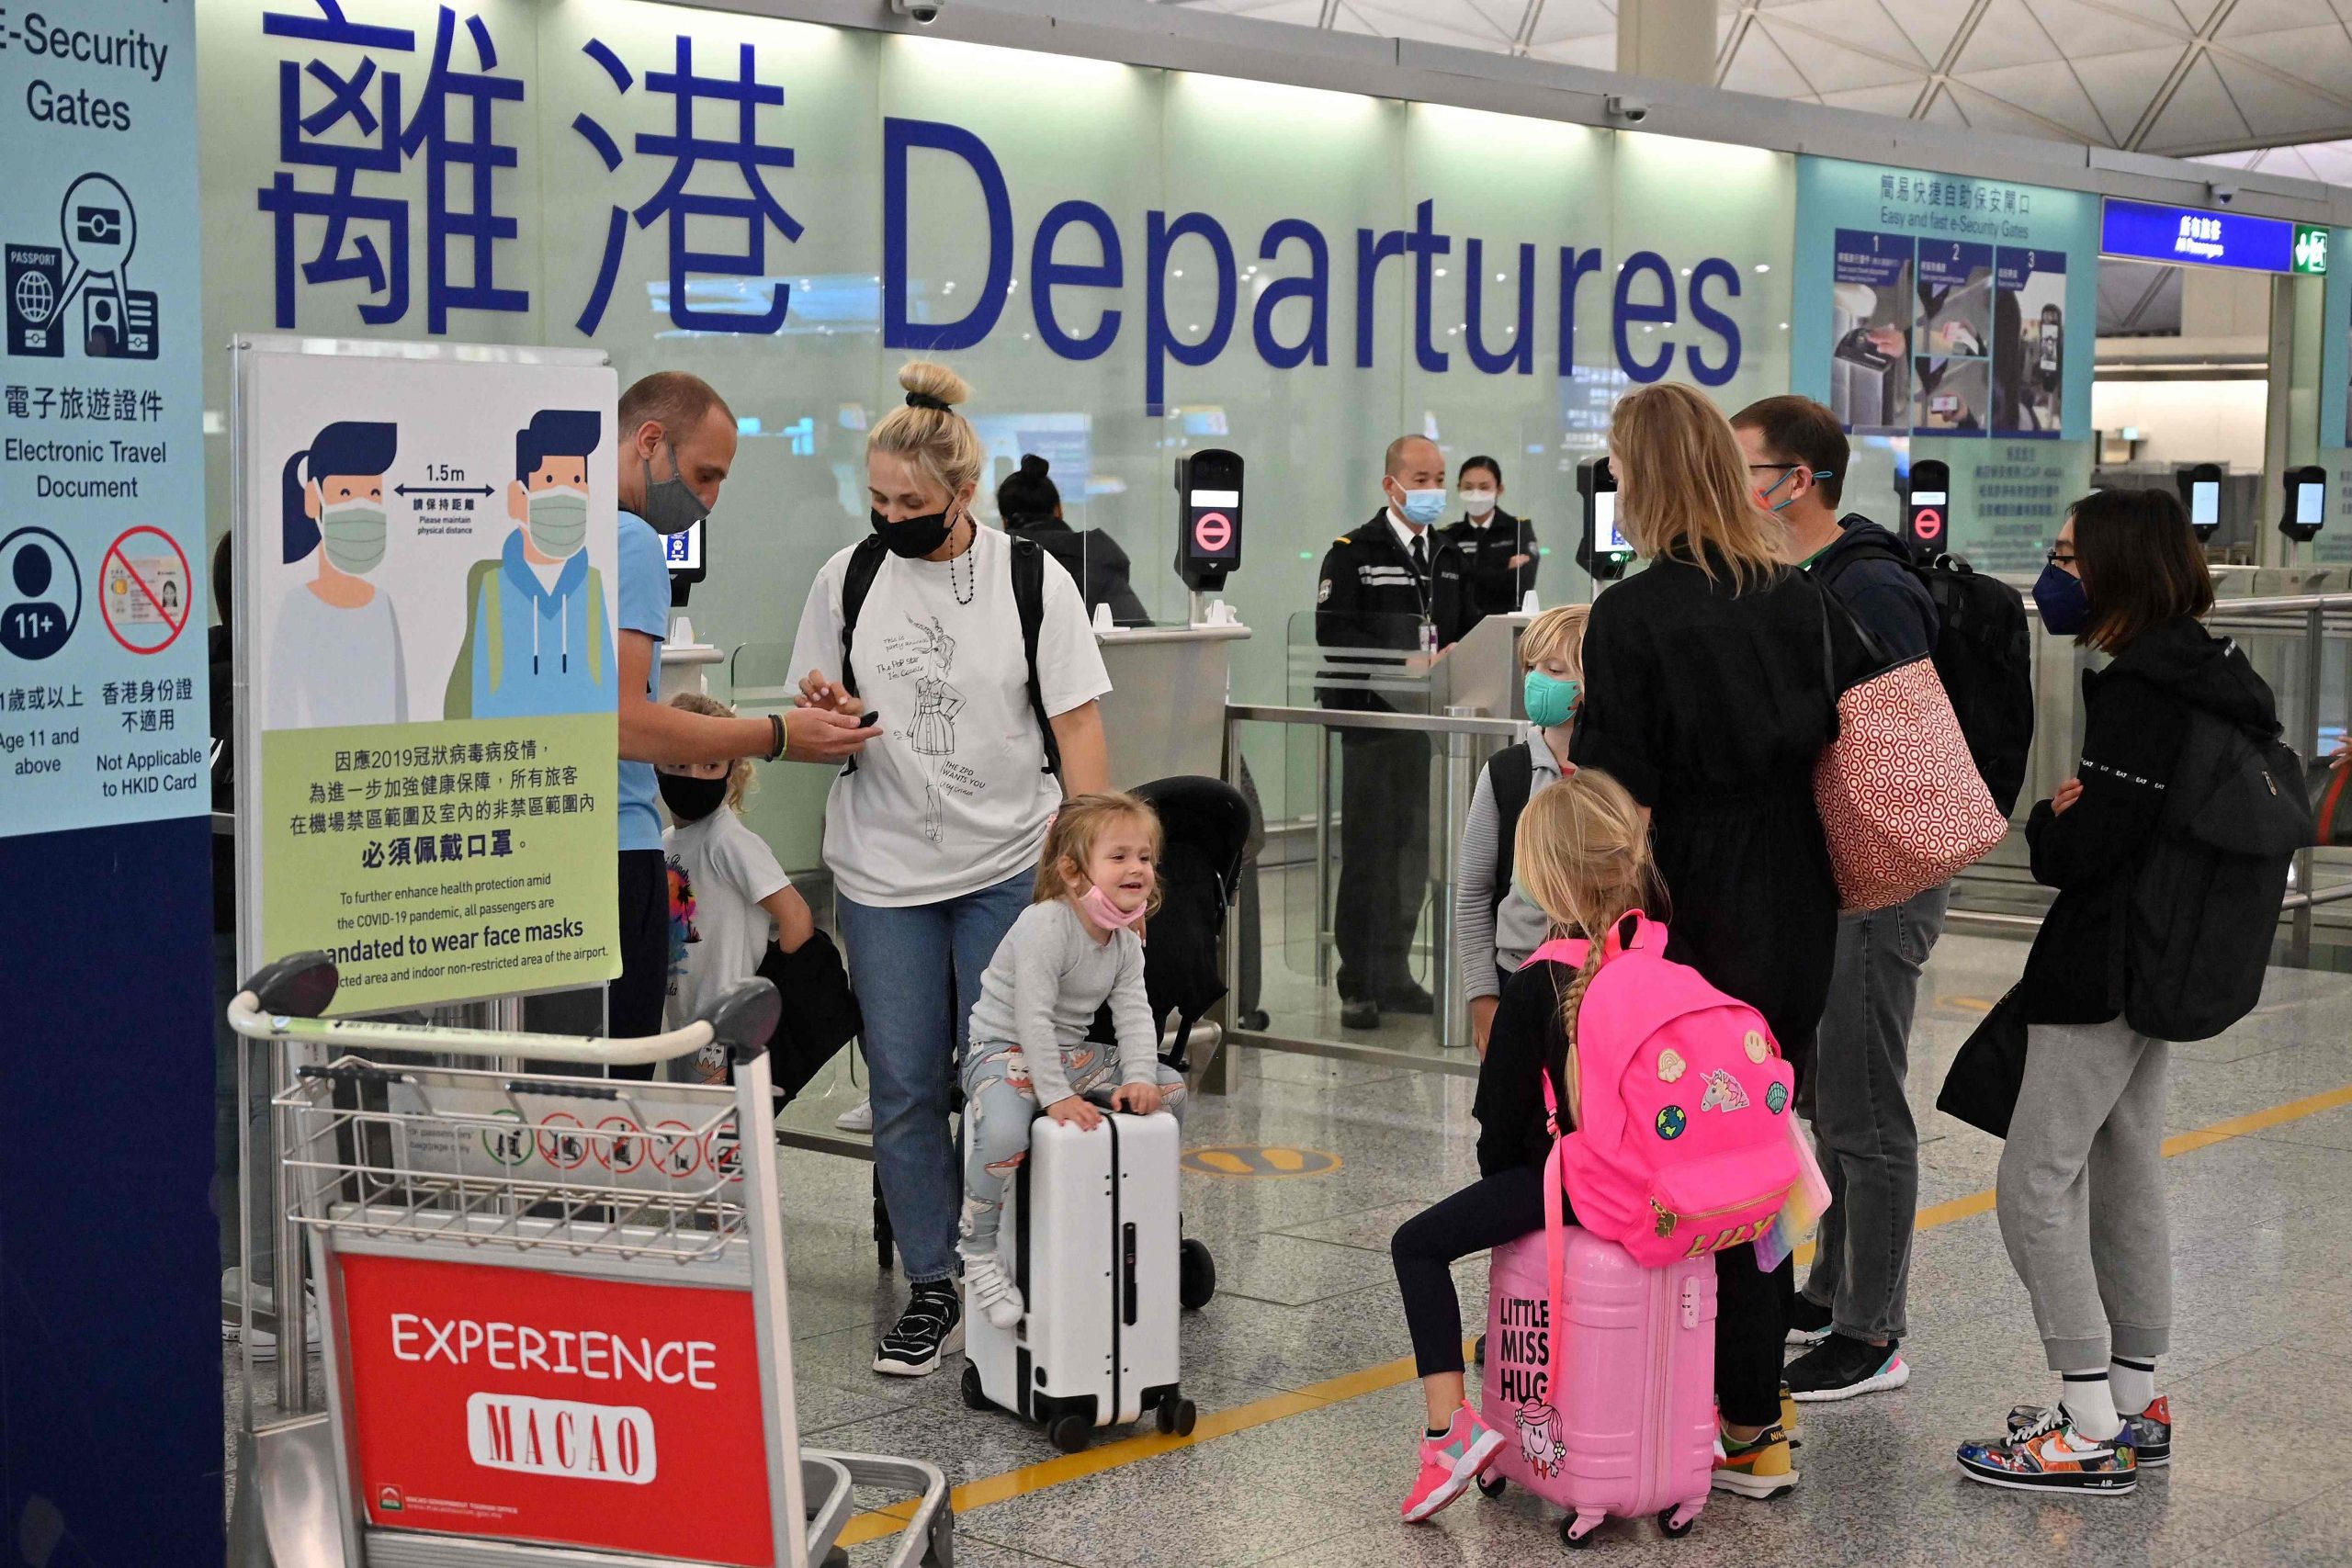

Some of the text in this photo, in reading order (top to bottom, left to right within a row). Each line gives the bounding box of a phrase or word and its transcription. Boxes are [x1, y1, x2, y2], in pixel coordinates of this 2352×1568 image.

[0, 8, 168, 82] -Security
[27, 79, 131, 131] Gates
[257, 0, 805, 337] 離港
[1881, 206, 2030, 240] Easy and fast e-Security Gates
[1872, 234, 1880, 253] 1
[1951, 243, 1961, 261] 2
[10, 251, 55, 266] PASSPORT
[883, 116, 1742, 417] Departures
[2027, 251, 2036, 268] 3
[5, 385, 164, 423] 電子旅遊證件
[5, 438, 167, 464] Electronic Travel
[426, 464, 465, 481] 1.5m
[37, 476, 139, 498] Document
[413, 498, 475, 511] 請保持距離
[417, 527, 445, 536] physical
[15, 613, 54, 639] 11+
[102, 678, 194, 707] 香港身份證
[121, 709, 175, 735] 不適用
[29, 729, 45, 747] 11
[51, 727, 79, 745] and
[15, 757, 62, 775] above
[96, 748, 202, 773] Not Applicable
[945, 761, 960, 772] THE
[103, 773, 198, 797] to HKID Card
[943, 768, 968, 784] WANTS
[968, 778, 986, 789] YOU
[341, 873, 552, 905] To further enhance health protection amid
[337, 898, 555, 930] the COVID-19 pandemic, all passengers are
[317, 918, 584, 964] andated to wear face masks
[365, 974, 388, 986] area
[390, 969, 410, 982] and
[413, 965, 446, 979] indoor
[447, 953, 518, 976] non-restricted
[521, 955, 542, 967] area
[544, 953, 555, 964] of
[556, 950, 571, 962] the
[573, 944, 609, 962] airport.
[1682, 1212, 1778, 1258] LILY
[1499, 1297, 1550, 1328] LITTLE
[390, 1314, 717, 1390] EXPERIENCE
[1500, 1329, 1550, 1367] MISS
[1499, 1368, 1549, 1406] HUG
[484, 1403, 641, 1476] MACAO
[2100, 1479, 2113, 1487] AIR
